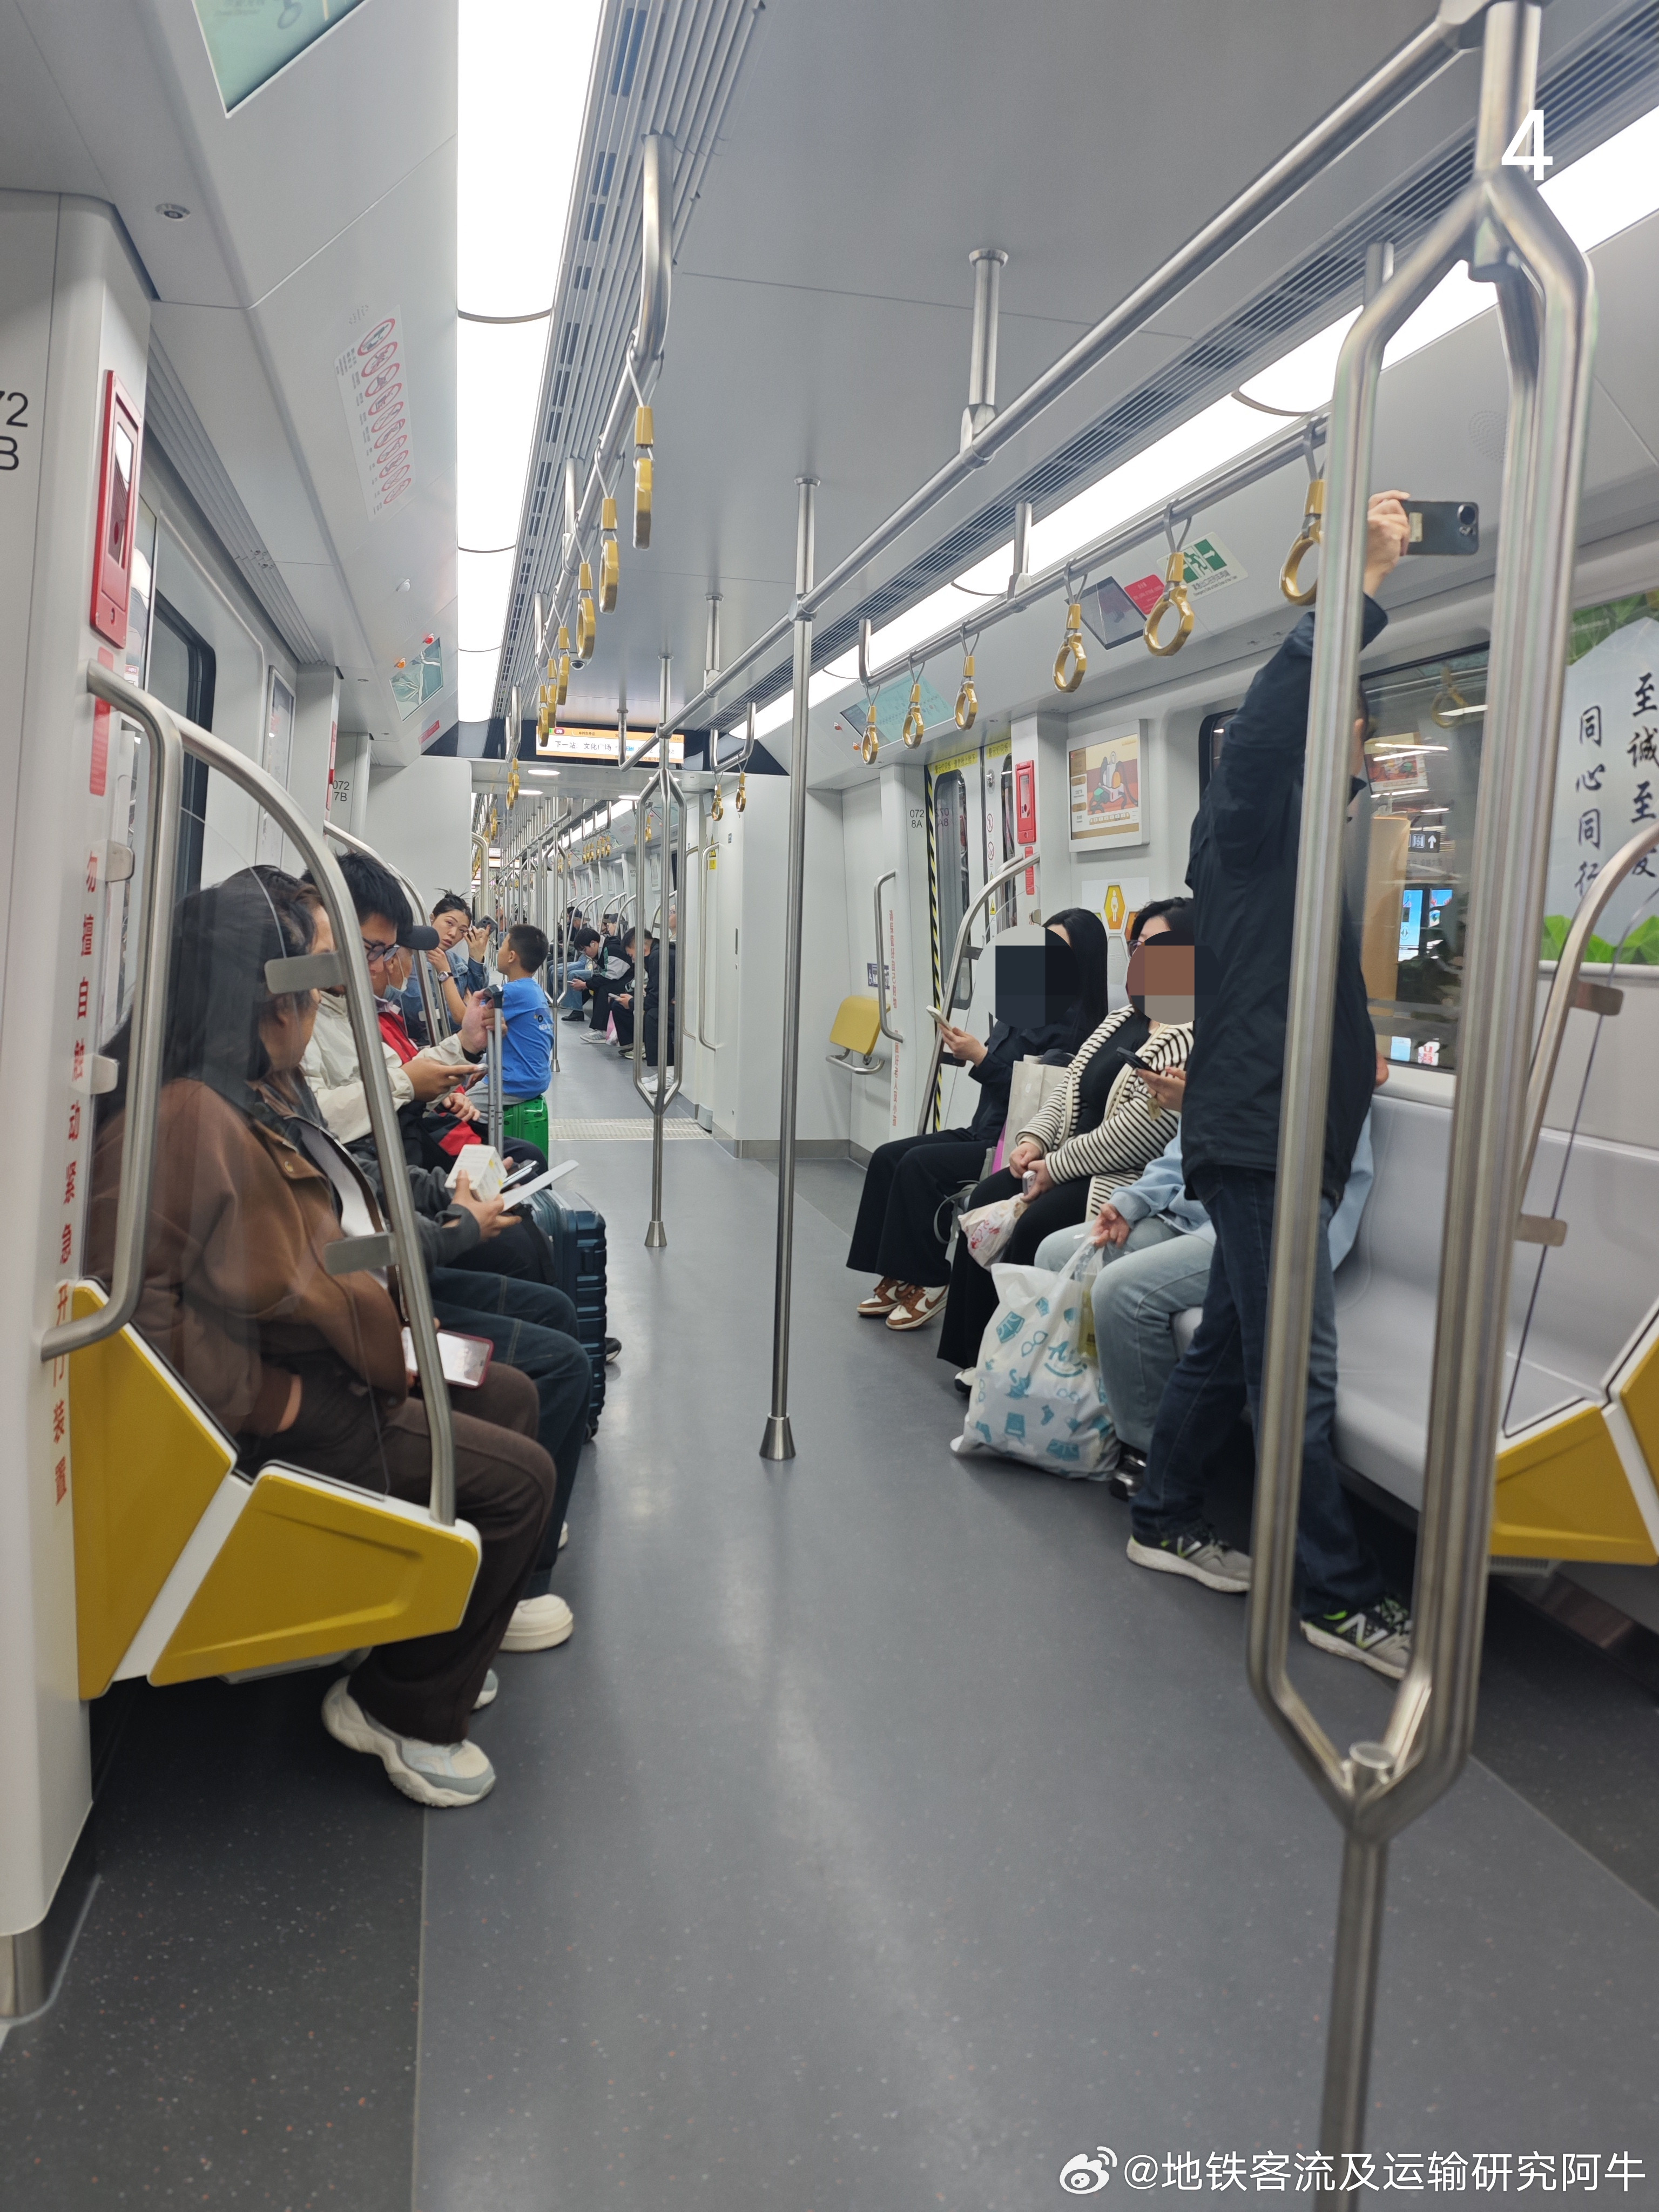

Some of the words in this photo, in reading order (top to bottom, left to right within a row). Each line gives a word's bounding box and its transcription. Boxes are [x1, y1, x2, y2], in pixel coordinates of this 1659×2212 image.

[0, 391, 28, 427] 2
[583, 743, 611, 751] 文化广场
[333, 780, 349, 790] 072
[334, 792, 347, 801] 7B
[909, 810, 924, 818] 072
[912, 820, 922, 828] 8A
